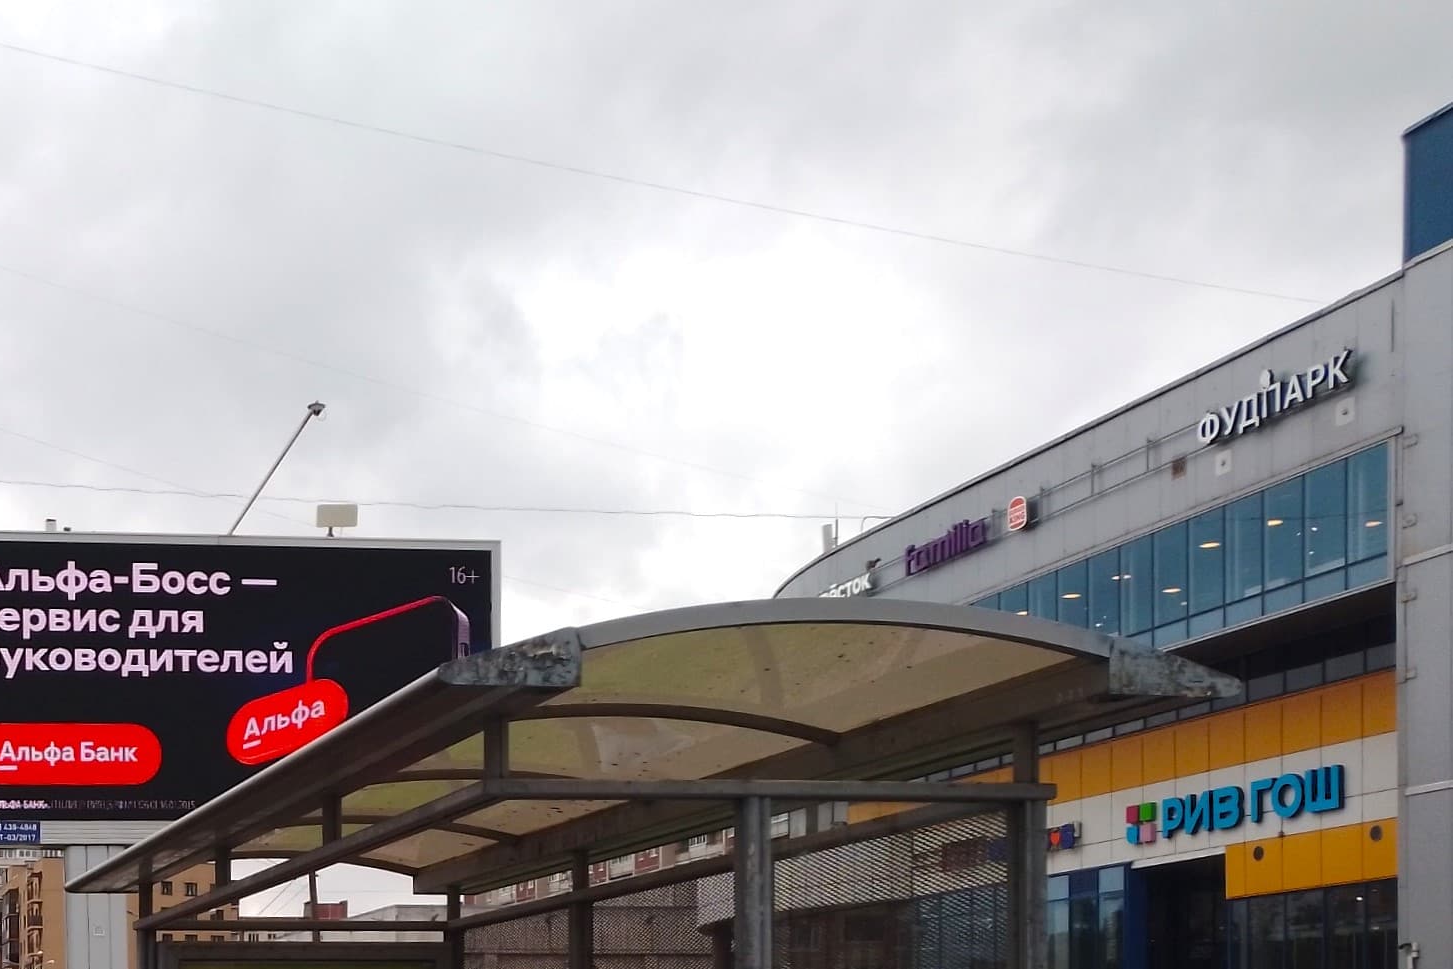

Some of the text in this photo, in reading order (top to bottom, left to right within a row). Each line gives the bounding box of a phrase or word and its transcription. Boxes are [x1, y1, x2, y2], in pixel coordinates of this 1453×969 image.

[1198, 349, 1351, 443] ФУДПАРК
[449, 566, 481, 584] 16+
[128, 609, 204, 639] для
[243, 700, 325, 748] Альфа
[80, 741, 139, 763] Банк
[1163, 765, 1344, 838] РИВ ГОШ
